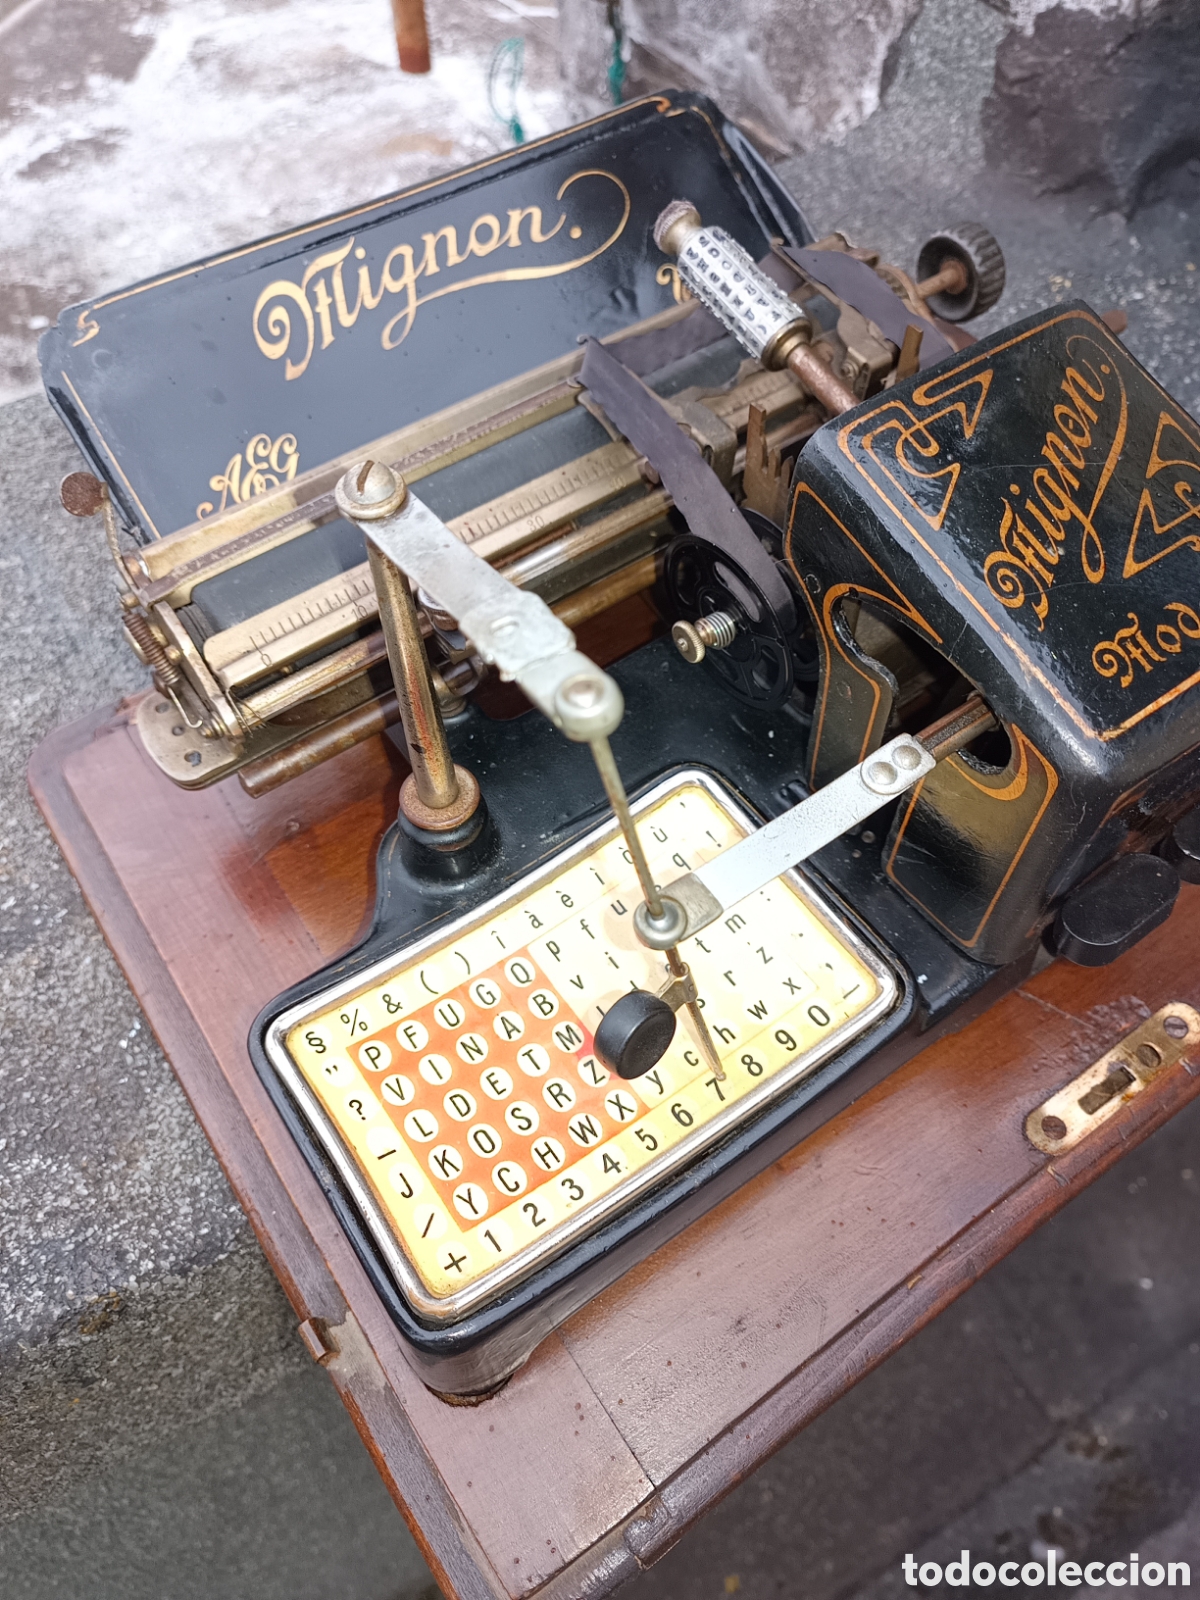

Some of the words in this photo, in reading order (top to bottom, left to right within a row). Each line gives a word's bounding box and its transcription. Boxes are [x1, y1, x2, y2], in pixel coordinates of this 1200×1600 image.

[196, 433, 300, 520] AEG
[340, 1009, 367, 1036] %
[382, 994, 402, 1014] &
[420, 971, 438, 994] (
[455, 952, 470, 974] )
[349, 1100, 365, 1120] ?
[385, 1078, 405, 1100] V
[461, 1037, 483, 1061] N
[501, 1017, 521, 1039] A
[533, 994, 553, 1016] B
[605, 952, 619, 969] i
[365, 1047, 380, 1069] P
[404, 1026, 417, 1049] F
[439, 1004, 460, 1027] U
[476, 984, 496, 1005] G
[511, 963, 532, 984] Q
[546, 941, 560, 962] p
[580, 919, 594, 939] f
[611, 900, 627, 915] u
[673, 853, 691, 870] q
[706, 831, 721, 847] !
[413, 1117, 433, 1137] L
[449, 1094, 470, 1117] D
[486, 1073, 506, 1095] E
[522, 1049, 540, 1070] T
[554, 1024, 583, 1051] M
[695, 938, 711, 953] t
[725, 914, 746, 933] m
[400, 1173, 413, 1198] J
[434, 1150, 459, 1177] K
[511, 1108, 532, 1130] S
[547, 1083, 571, 1107] R
[583, 1059, 607, 1085] Z
[724, 971, 736, 986] r
[756, 947, 773, 964] z
[444, 1253, 466, 1272] +
[484, 1230, 501, 1252] 1
[523, 1203, 546, 1227] 2
[561, 1179, 583, 1200] 3
[603, 1153, 621, 1173] 4
[635, 1129, 658, 1151] 5
[671, 1103, 693, 1127] 6
[705, 1077, 726, 1102] 7
[741, 1055, 763, 1076] 8
[775, 1030, 797, 1051] 9
[456, 1188, 478, 1214] Y
[498, 1168, 519, 1192] C
[534, 1142, 560, 1169] H
[569, 1115, 598, 1144] W
[608, 1094, 634, 1120] X
[646, 1071, 663, 1095] y
[684, 1051, 699, 1066] c
[713, 1026, 736, 1044] h
[747, 1000, 767, 1019] w
[783, 978, 801, 995] x
